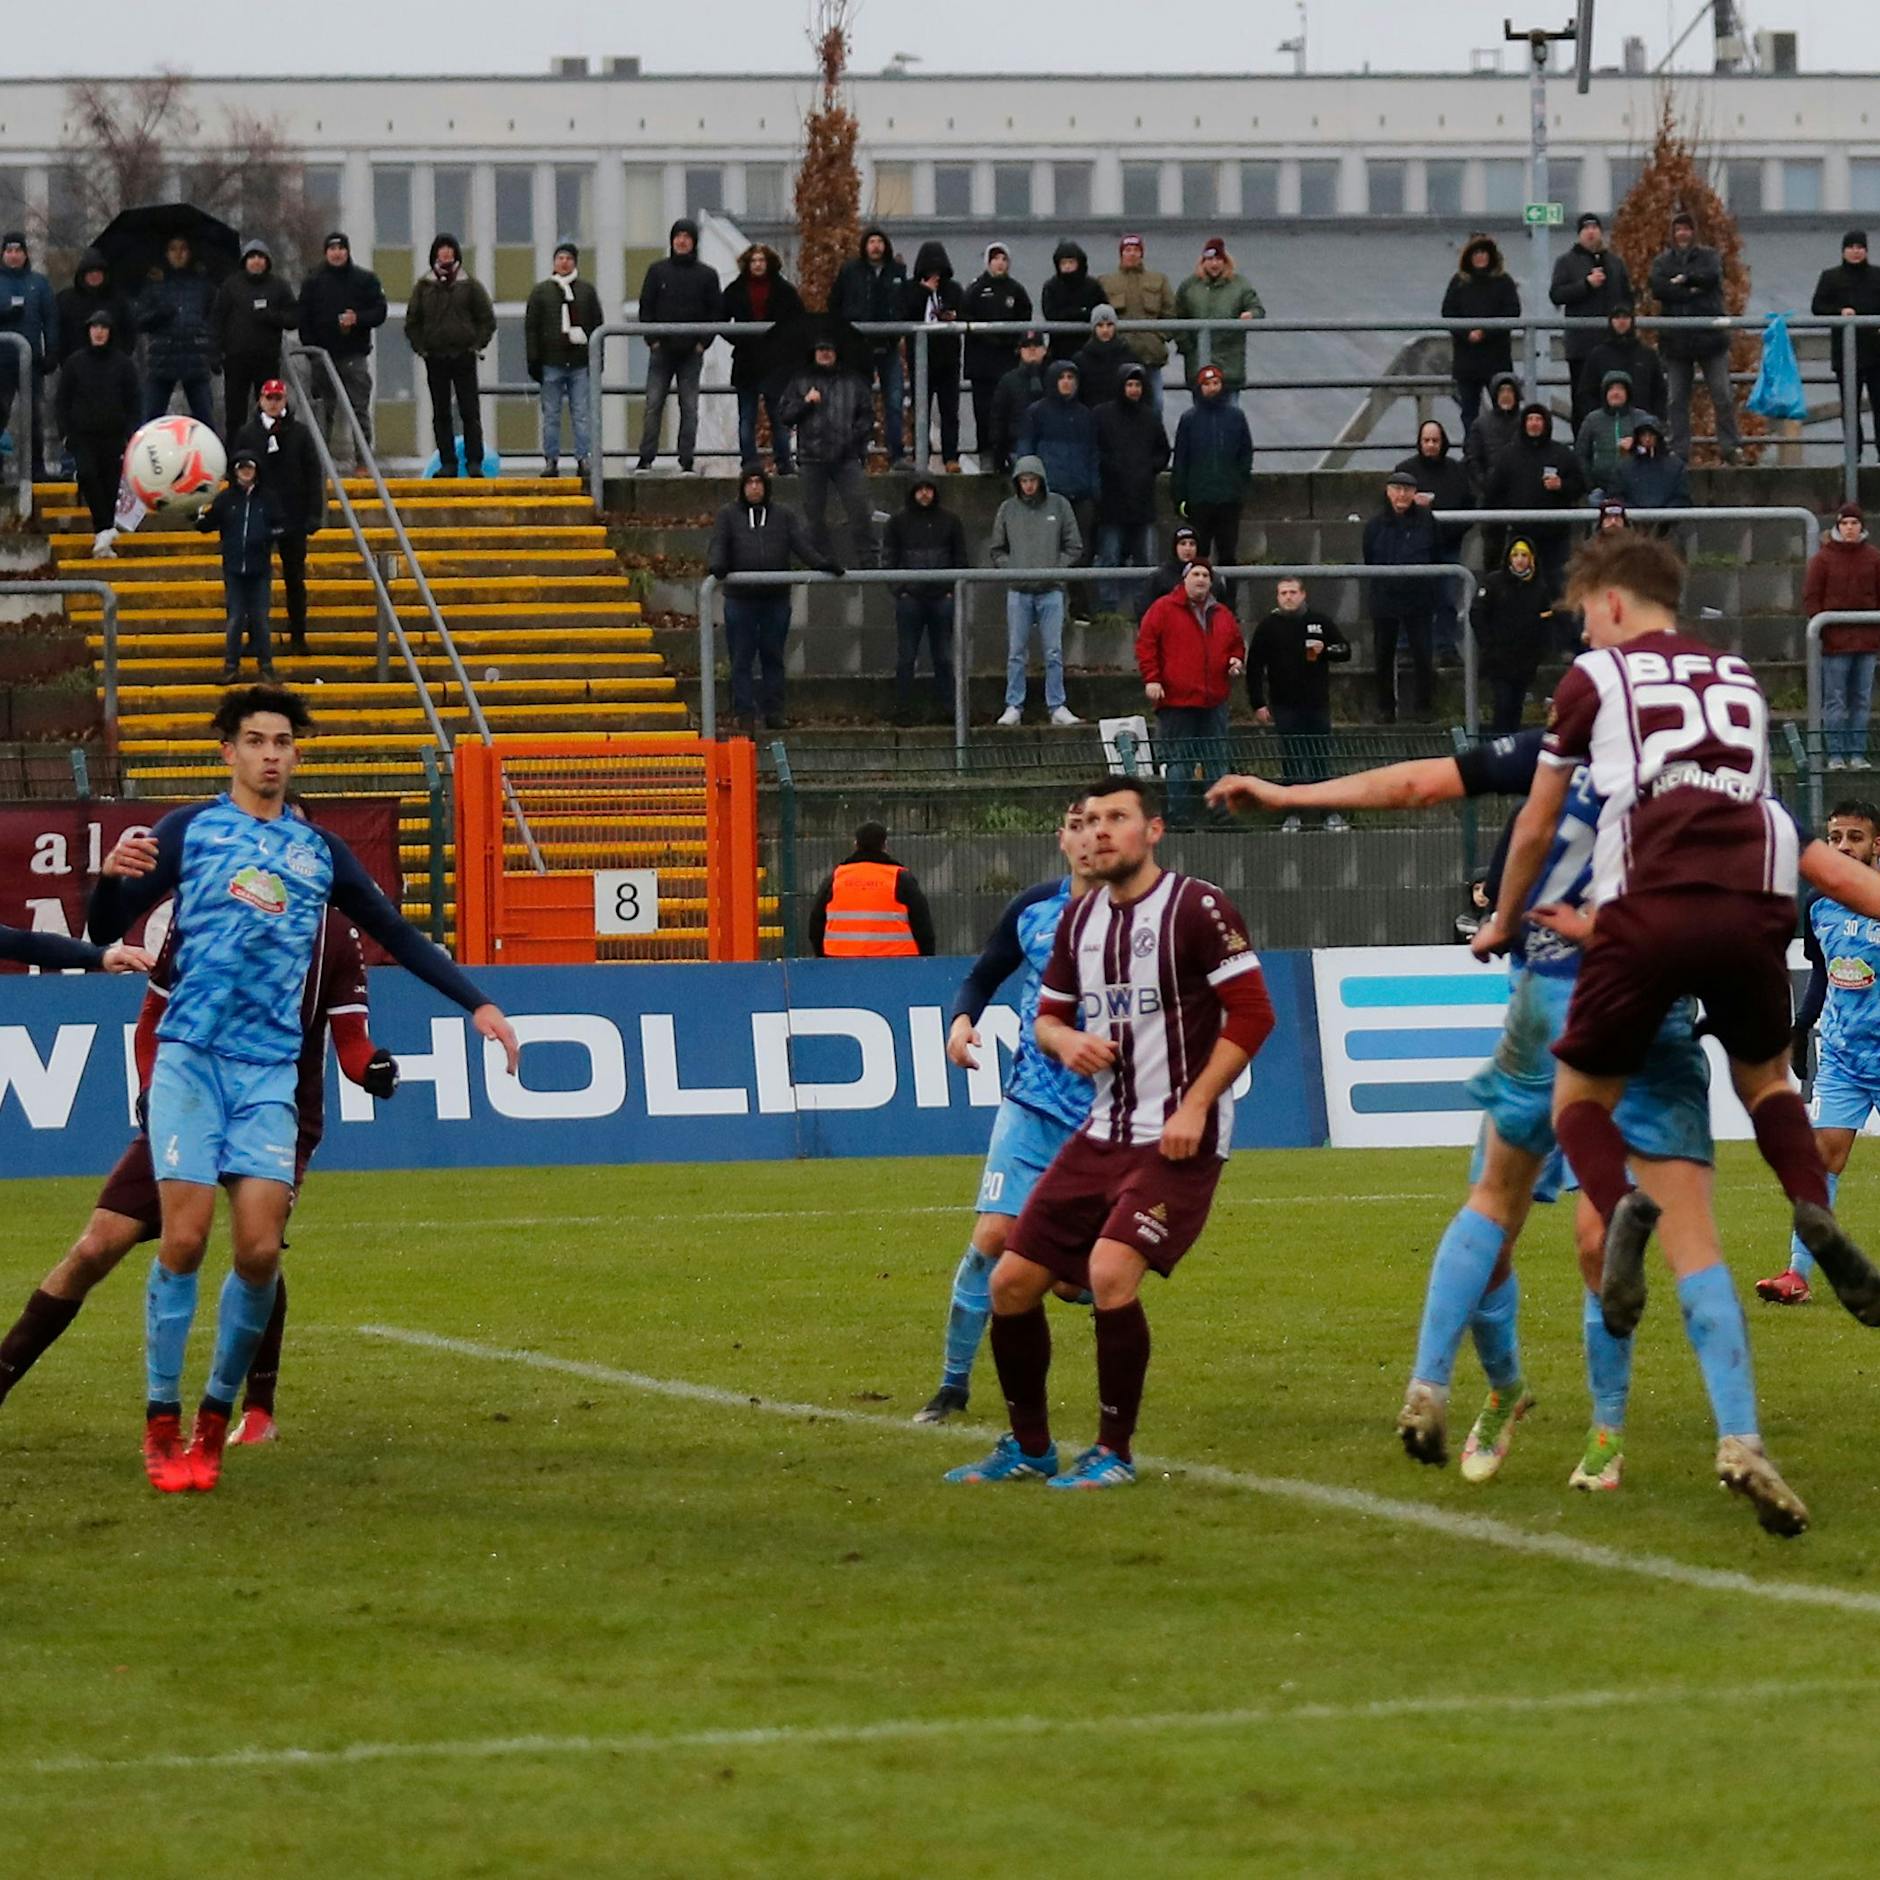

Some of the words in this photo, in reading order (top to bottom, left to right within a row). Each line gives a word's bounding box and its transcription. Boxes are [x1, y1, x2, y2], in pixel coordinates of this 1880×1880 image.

[1625, 651, 1758, 687] BFC
[1634, 683, 1767, 798] 29
[615, 882, 640, 922] 8
[1843, 918, 1858, 937] 30
[1081, 987, 1161, 1019] DWB
[336, 1004, 1252, 1122] HOLDIN
